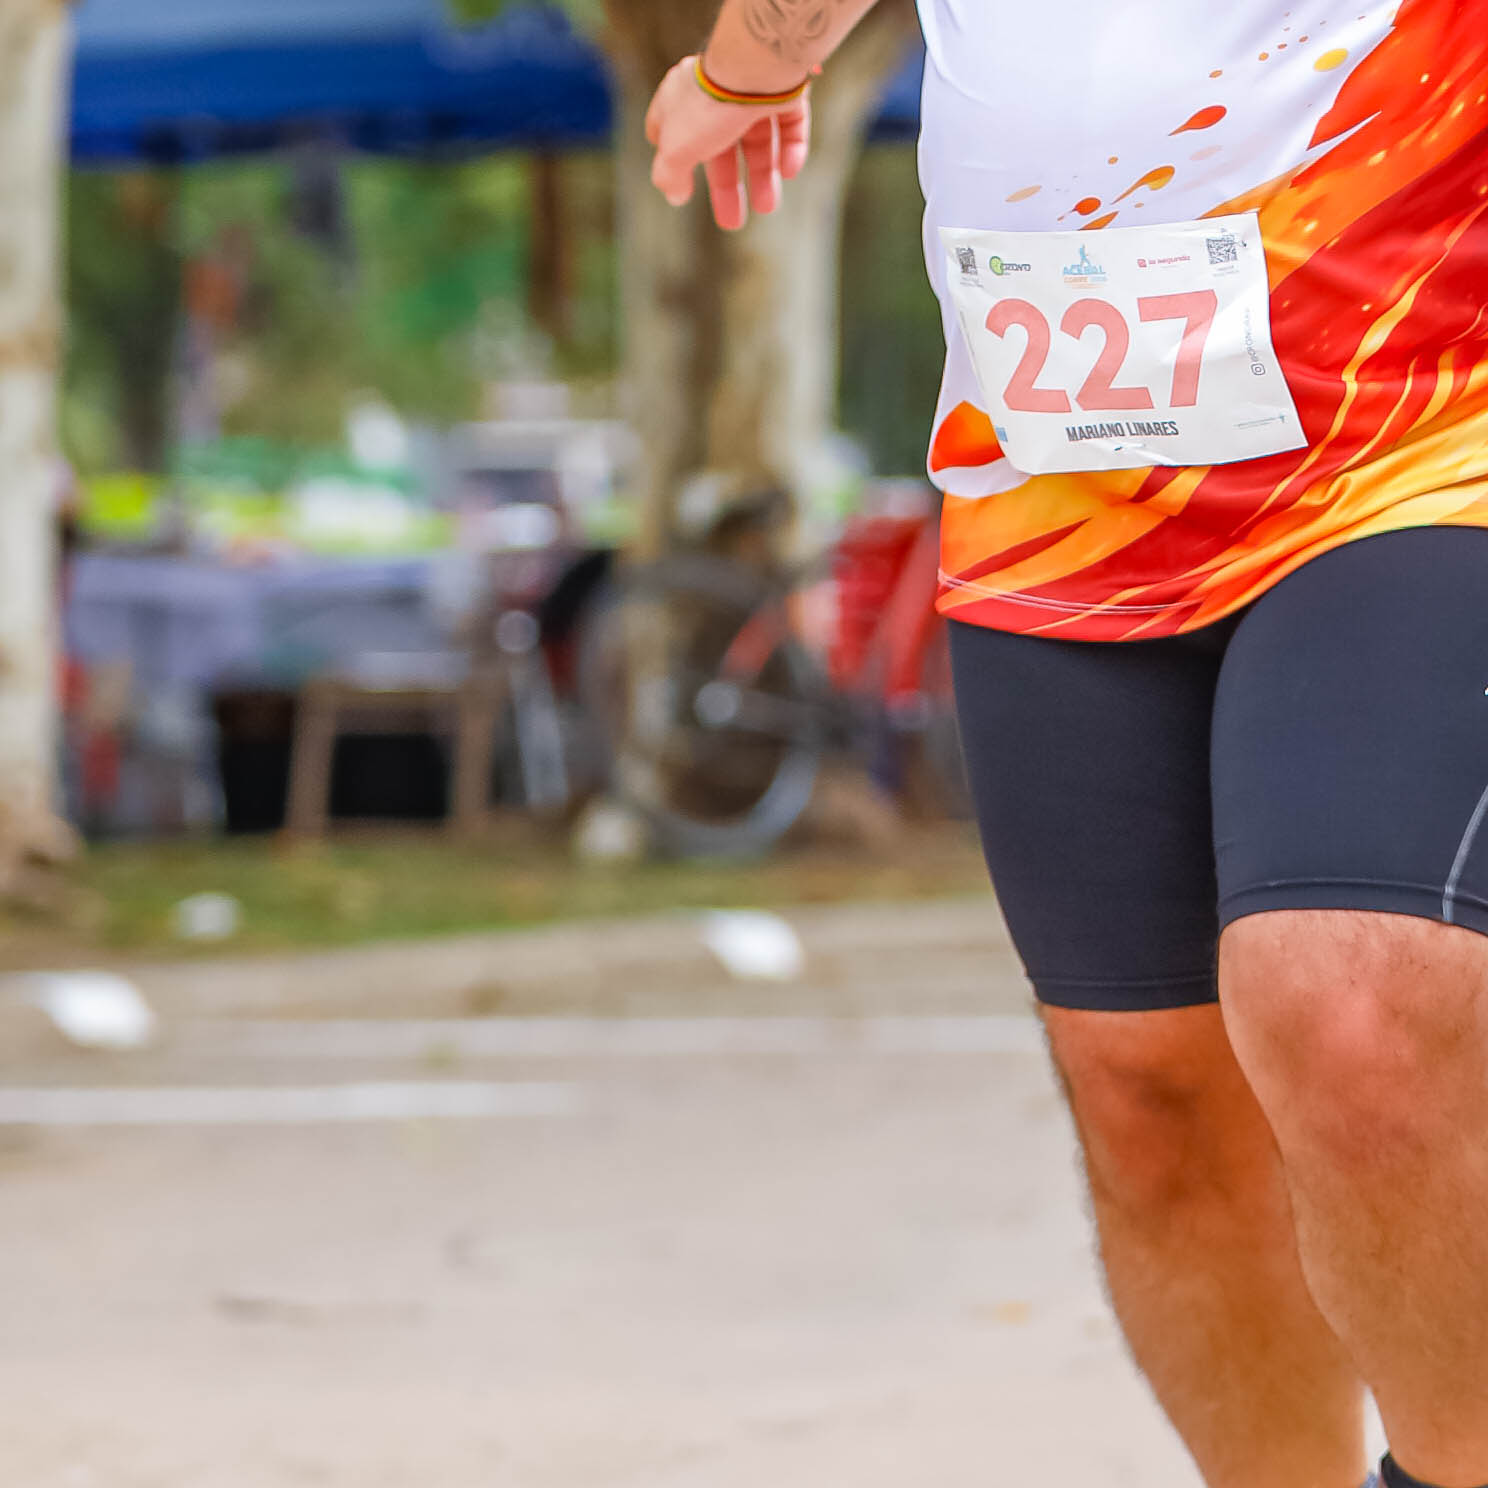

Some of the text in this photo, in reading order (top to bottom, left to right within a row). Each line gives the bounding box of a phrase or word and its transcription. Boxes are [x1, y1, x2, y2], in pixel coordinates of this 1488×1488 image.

[985, 289, 1218, 413] 227
[1065, 421, 1179, 442] MARIANO LINARES
